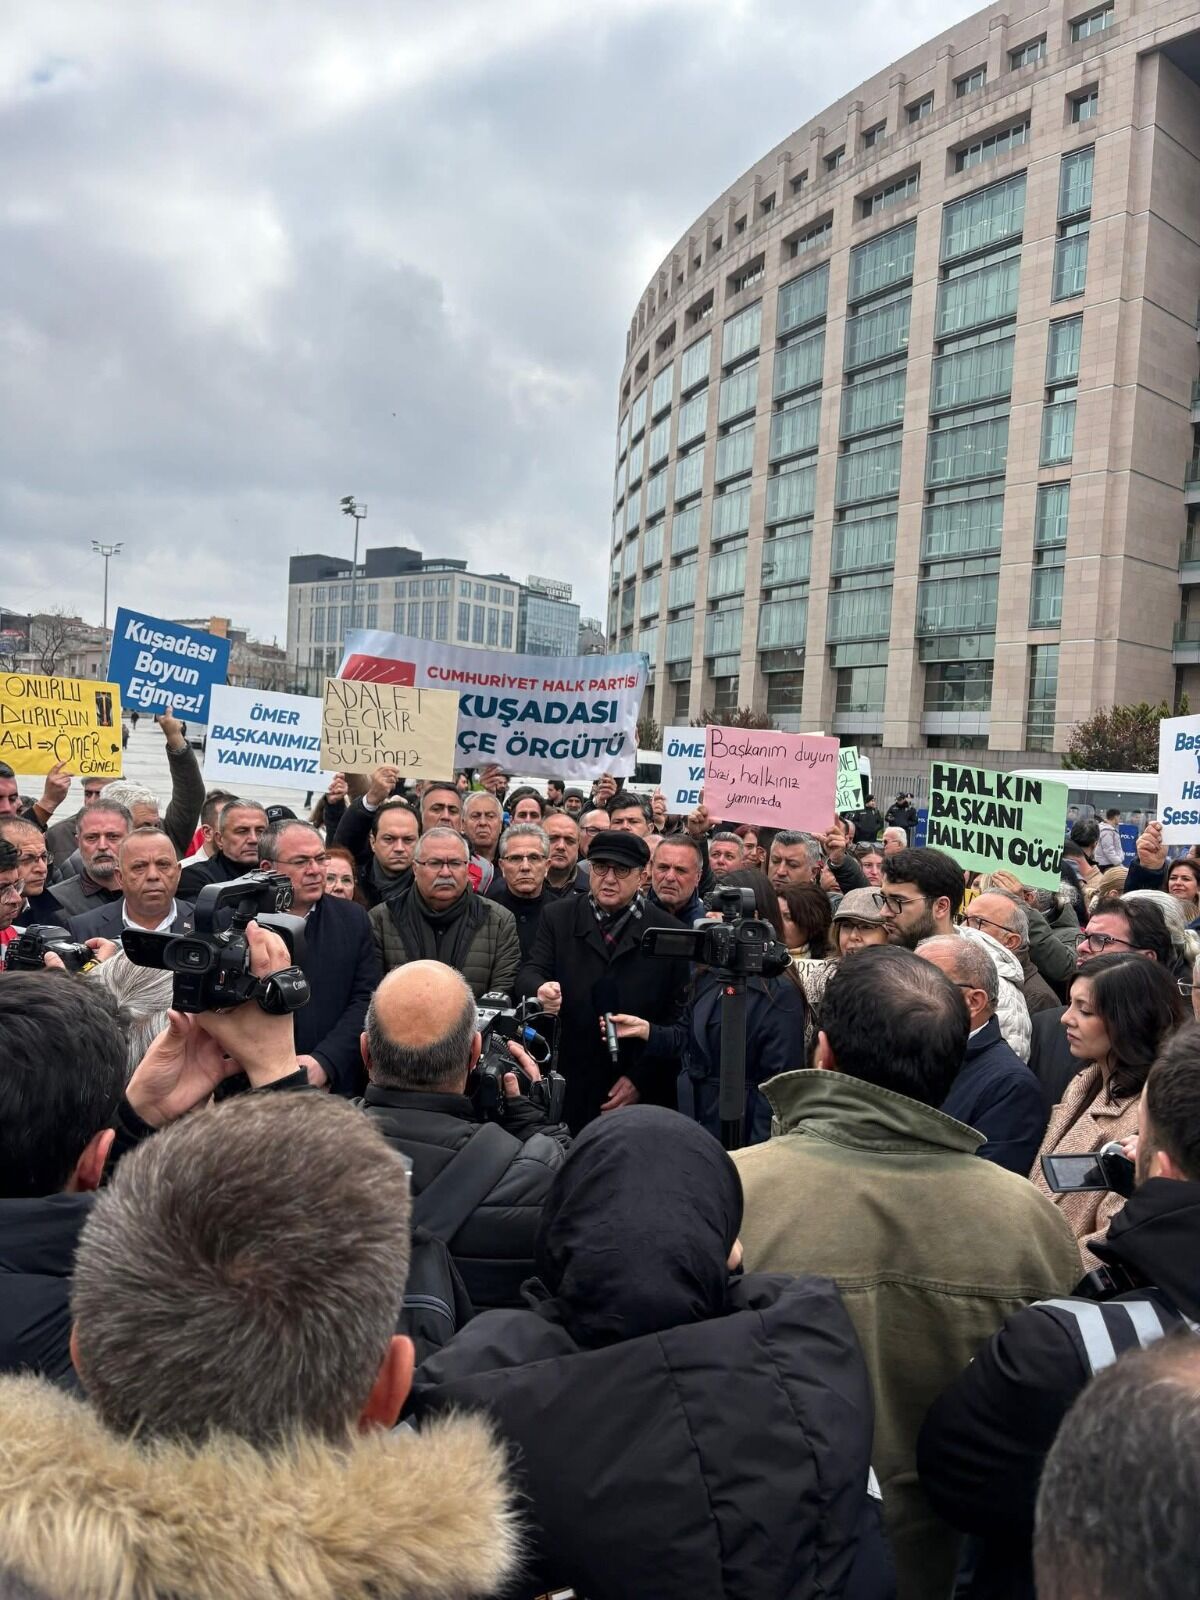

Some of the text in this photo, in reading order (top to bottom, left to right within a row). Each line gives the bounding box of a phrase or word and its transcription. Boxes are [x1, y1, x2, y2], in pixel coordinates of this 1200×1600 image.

[124, 619, 217, 663] Kuşadası
[134, 650, 200, 685] Boyun
[427, 666, 640, 692] CUMHURİYET HALK PARTİSİ
[6, 676, 81, 702] ONURLU
[126, 676, 205, 713] Eğmez!
[326, 680, 428, 714] ADALET
[1, 704, 88, 729] DURUŞUN
[250, 703, 300, 725] ÖMER
[459, 694, 618, 727] KUŞADASI
[54, 730, 106, 763] ÖMER
[325, 728, 386, 748] HALK
[456, 730, 625, 759] ÇE ÖRGÜTÜ
[667, 739, 706, 758] ÖME
[711, 729, 834, 768] Başkanım duyun
[80, 760, 119, 773] GÜNEL
[708, 761, 800, 789] bizi, halkınız
[933, 764, 1042, 804] HALKIN
[725, 792, 781, 809] yanınızda
[931, 792, 1023, 831] BAŞKANI
[928, 820, 1063, 874] HALKIN GÜCÜ
